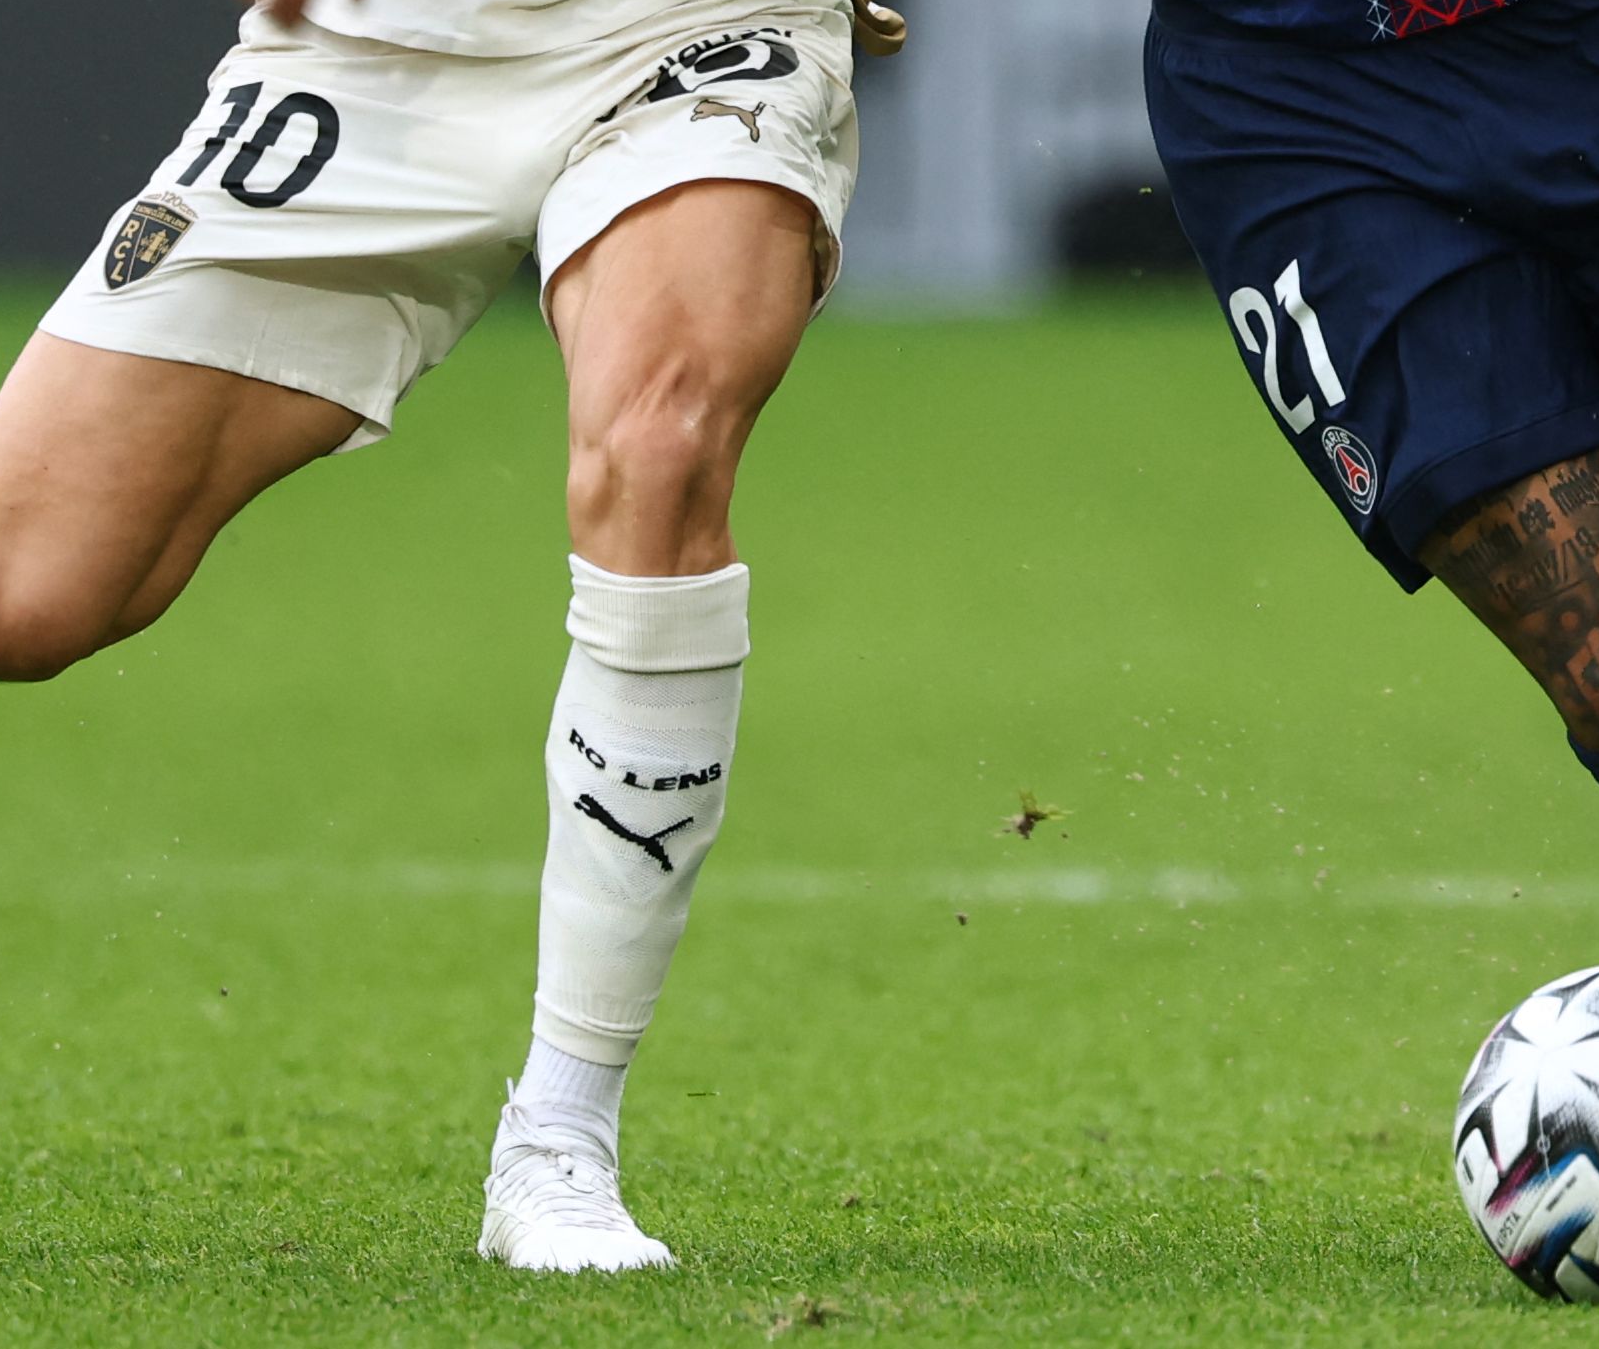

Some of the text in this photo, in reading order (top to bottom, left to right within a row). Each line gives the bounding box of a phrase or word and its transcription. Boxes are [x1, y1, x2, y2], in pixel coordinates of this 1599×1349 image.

[175, 81, 340, 209] 10
[1229, 258, 1346, 435] 21
[622, 762, 722, 791] LENS
